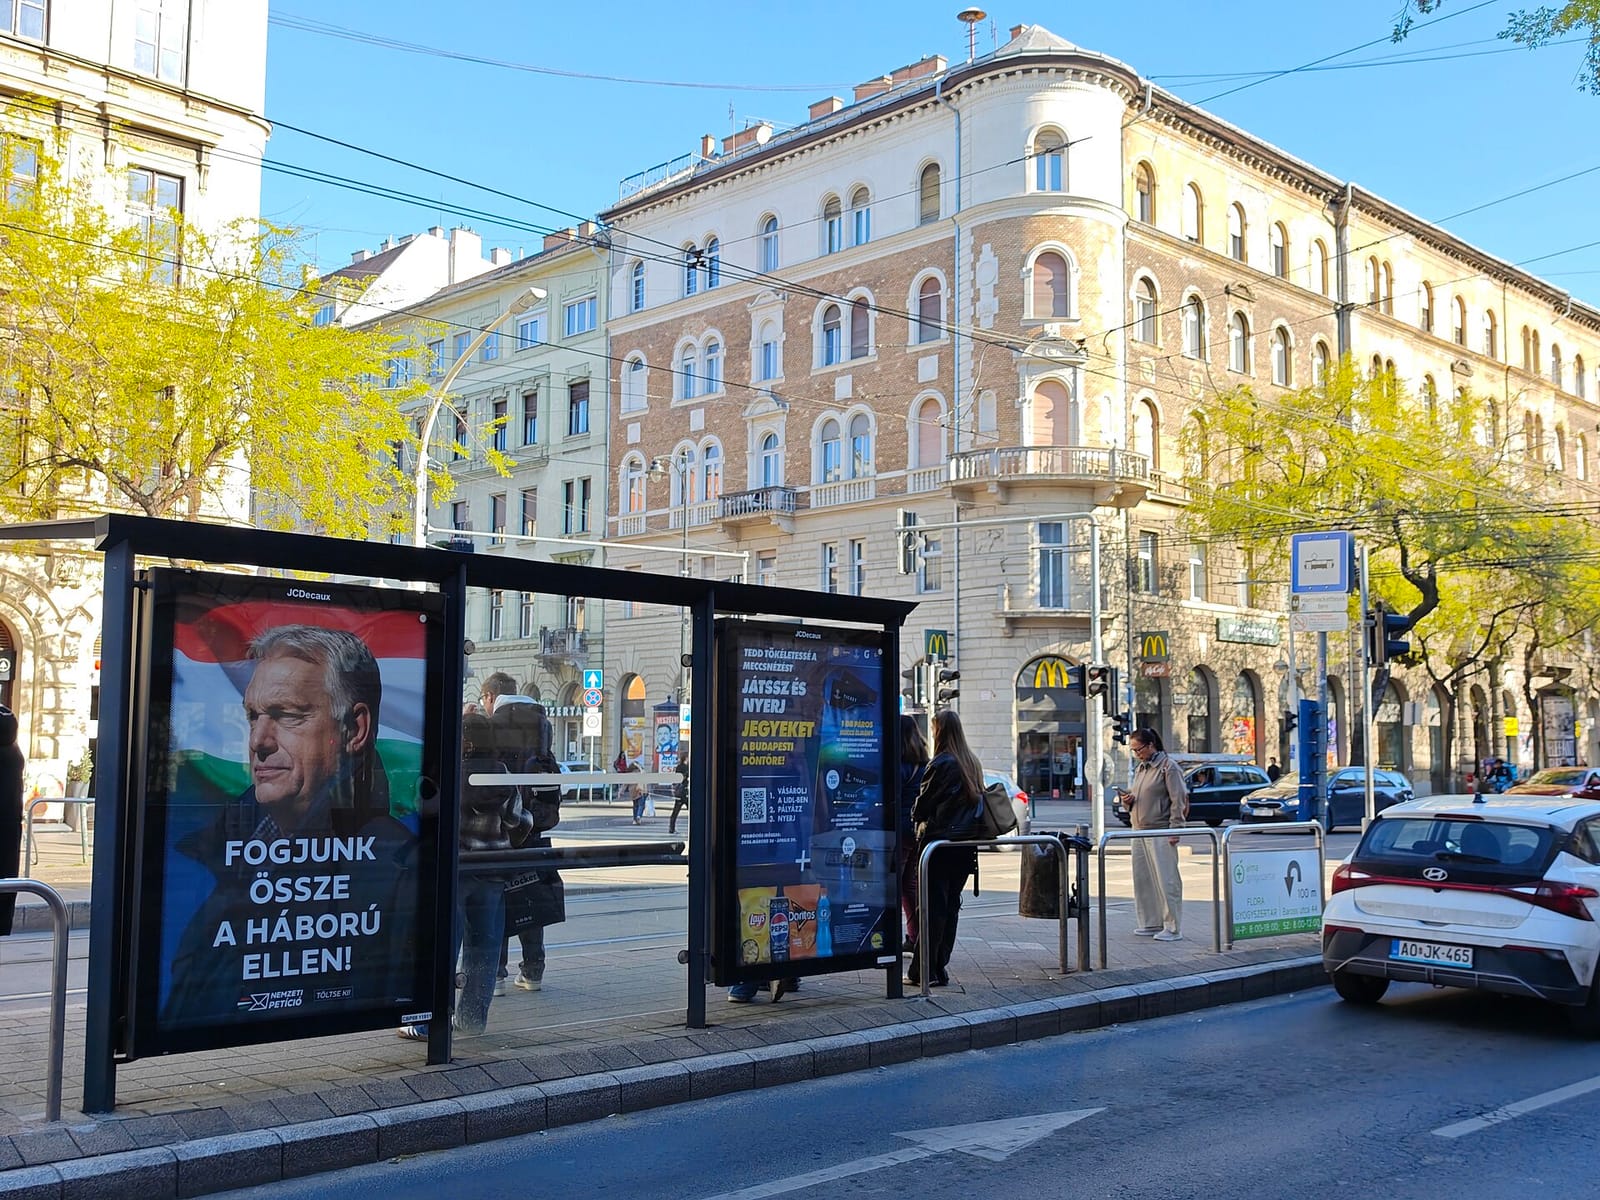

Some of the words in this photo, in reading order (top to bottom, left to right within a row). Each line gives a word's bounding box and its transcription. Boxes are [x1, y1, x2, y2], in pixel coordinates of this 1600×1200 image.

[286, 588, 330, 600] JCDecaux
[795, 630, 822, 639] JCDecaux
[744, 648, 763, 658] TEDD
[764, 647, 811, 660] TÖKÉLETESSÉ
[811, 652, 817, 661] A
[743, 661, 794, 672] MECCSNÉZÉST
[742, 675, 790, 695] JÁTSSZ
[791, 677, 807, 696] ÉS
[743, 698, 786, 714] NYERJ
[742, 720, 815, 737] JEGYEKET
[742, 742, 748, 751] A
[750, 742, 794, 751] BUDAPESTI
[742, 753, 785, 765] DÖNTŐRE!
[225, 836, 376, 866] FOGJUNK
[250, 871, 350, 904] ÖSSZE
[1297, 888, 1309, 898] 100
[1247, 897, 1264, 906] FLORA
[789, 910, 815, 921] Doritos
[212, 920, 237, 947] A
[246, 903, 381, 945] HÁBORÚ
[1401, 942, 1417, 957] AO
[1424, 945, 1470, 962] JK-465
[242, 946, 352, 980] ELLEN!
[270, 989, 304, 999] NEMZETI
[316, 990, 340, 999] TÖLTSE
[268, 998, 302, 1009] PETÍCIÓ
